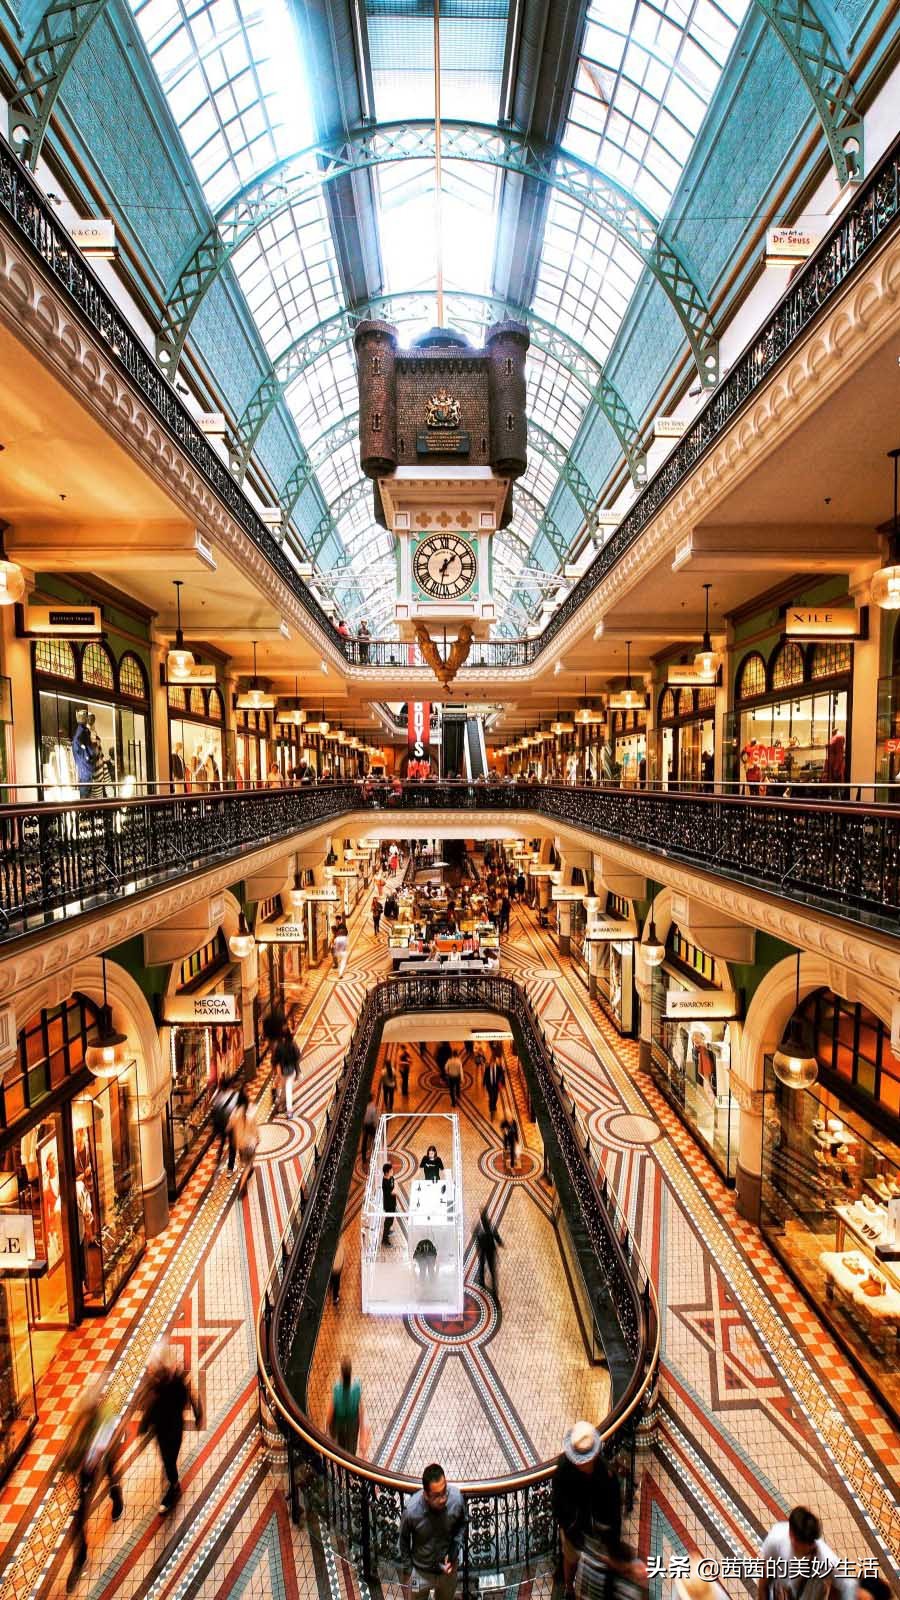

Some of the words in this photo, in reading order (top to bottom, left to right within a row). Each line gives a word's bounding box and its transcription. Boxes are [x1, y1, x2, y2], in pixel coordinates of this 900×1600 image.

[773, 235, 785, 243] Dr.
[787, 236, 811, 245] Seuss
[793, 614, 833, 623] XILE
[751, 748, 782, 764] SALE
[193, 999, 227, 1007] MECCA
